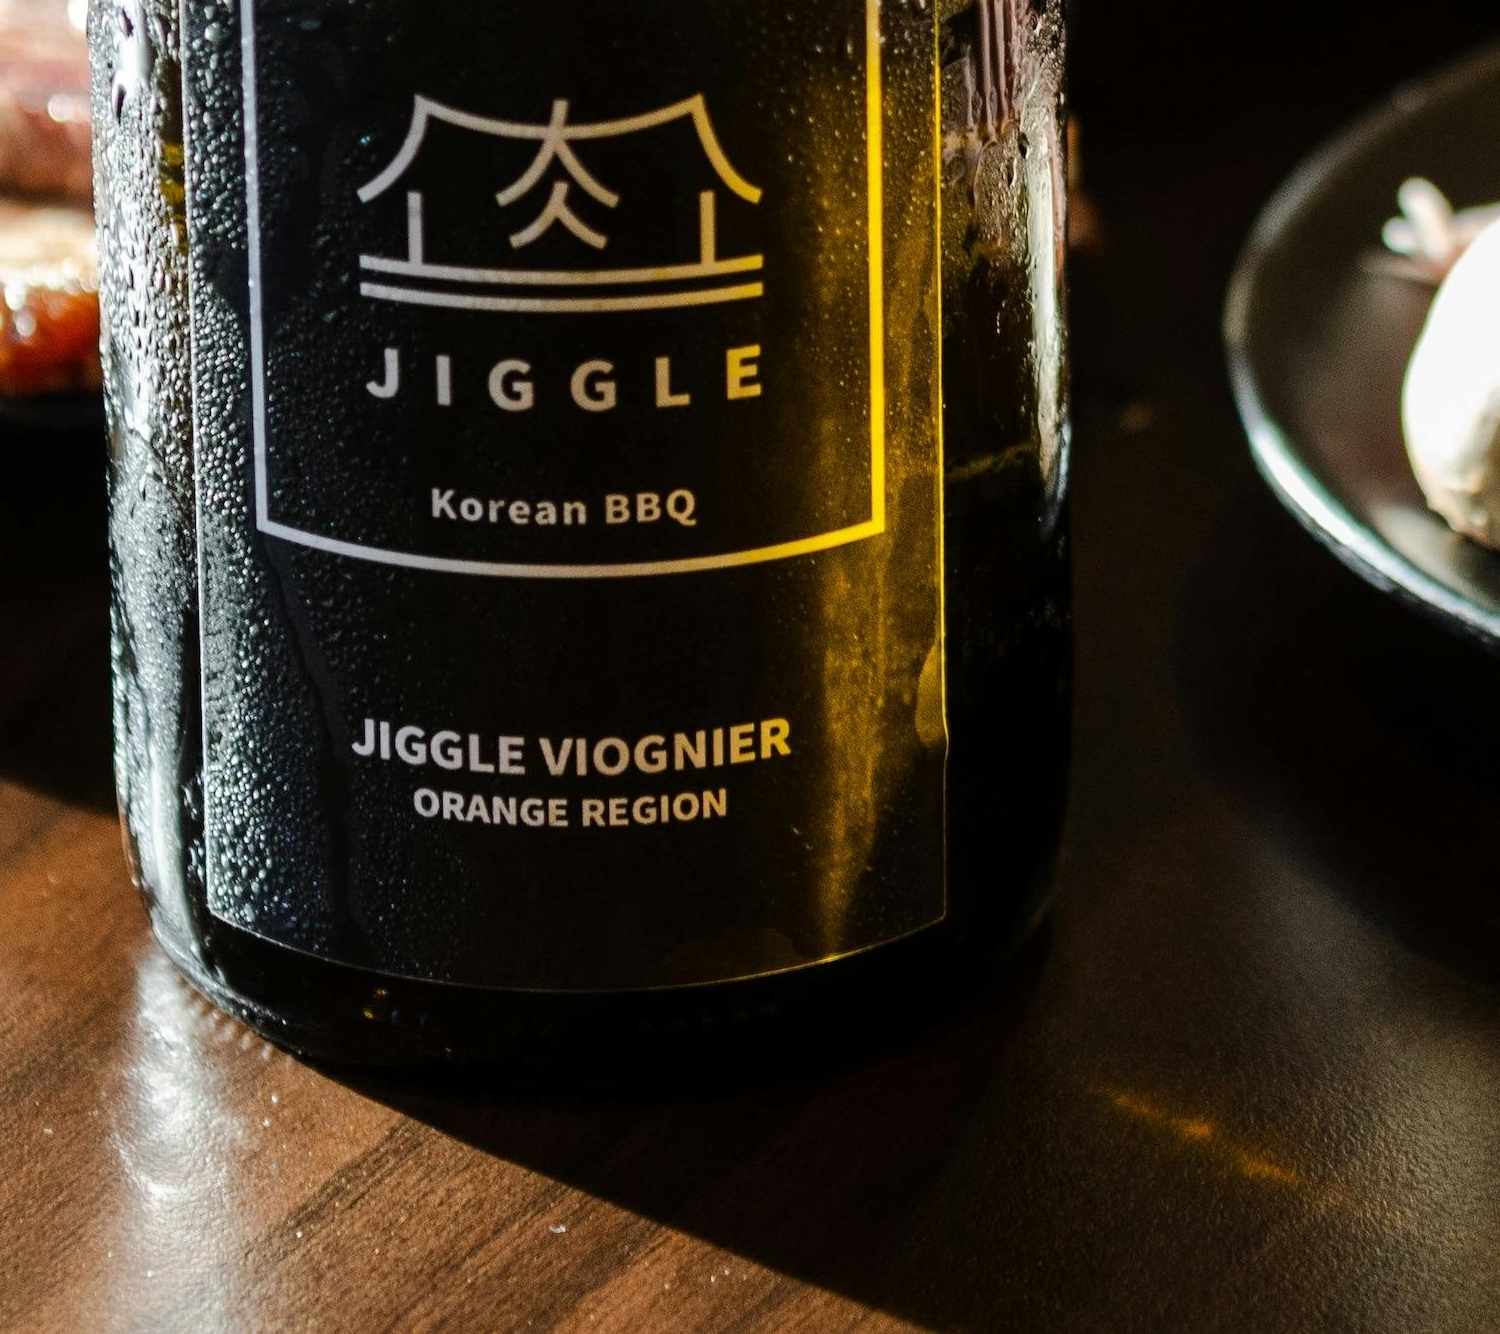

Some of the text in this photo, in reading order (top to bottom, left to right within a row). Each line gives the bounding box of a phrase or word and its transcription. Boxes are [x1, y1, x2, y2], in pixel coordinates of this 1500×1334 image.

[365, 343, 763, 413] JIGGLE
[430, 487, 698, 526] Korean BBQ
[350, 716, 793, 777] JIGGLE VIOGNIER
[412, 786, 729, 828] ORANGE REGION
